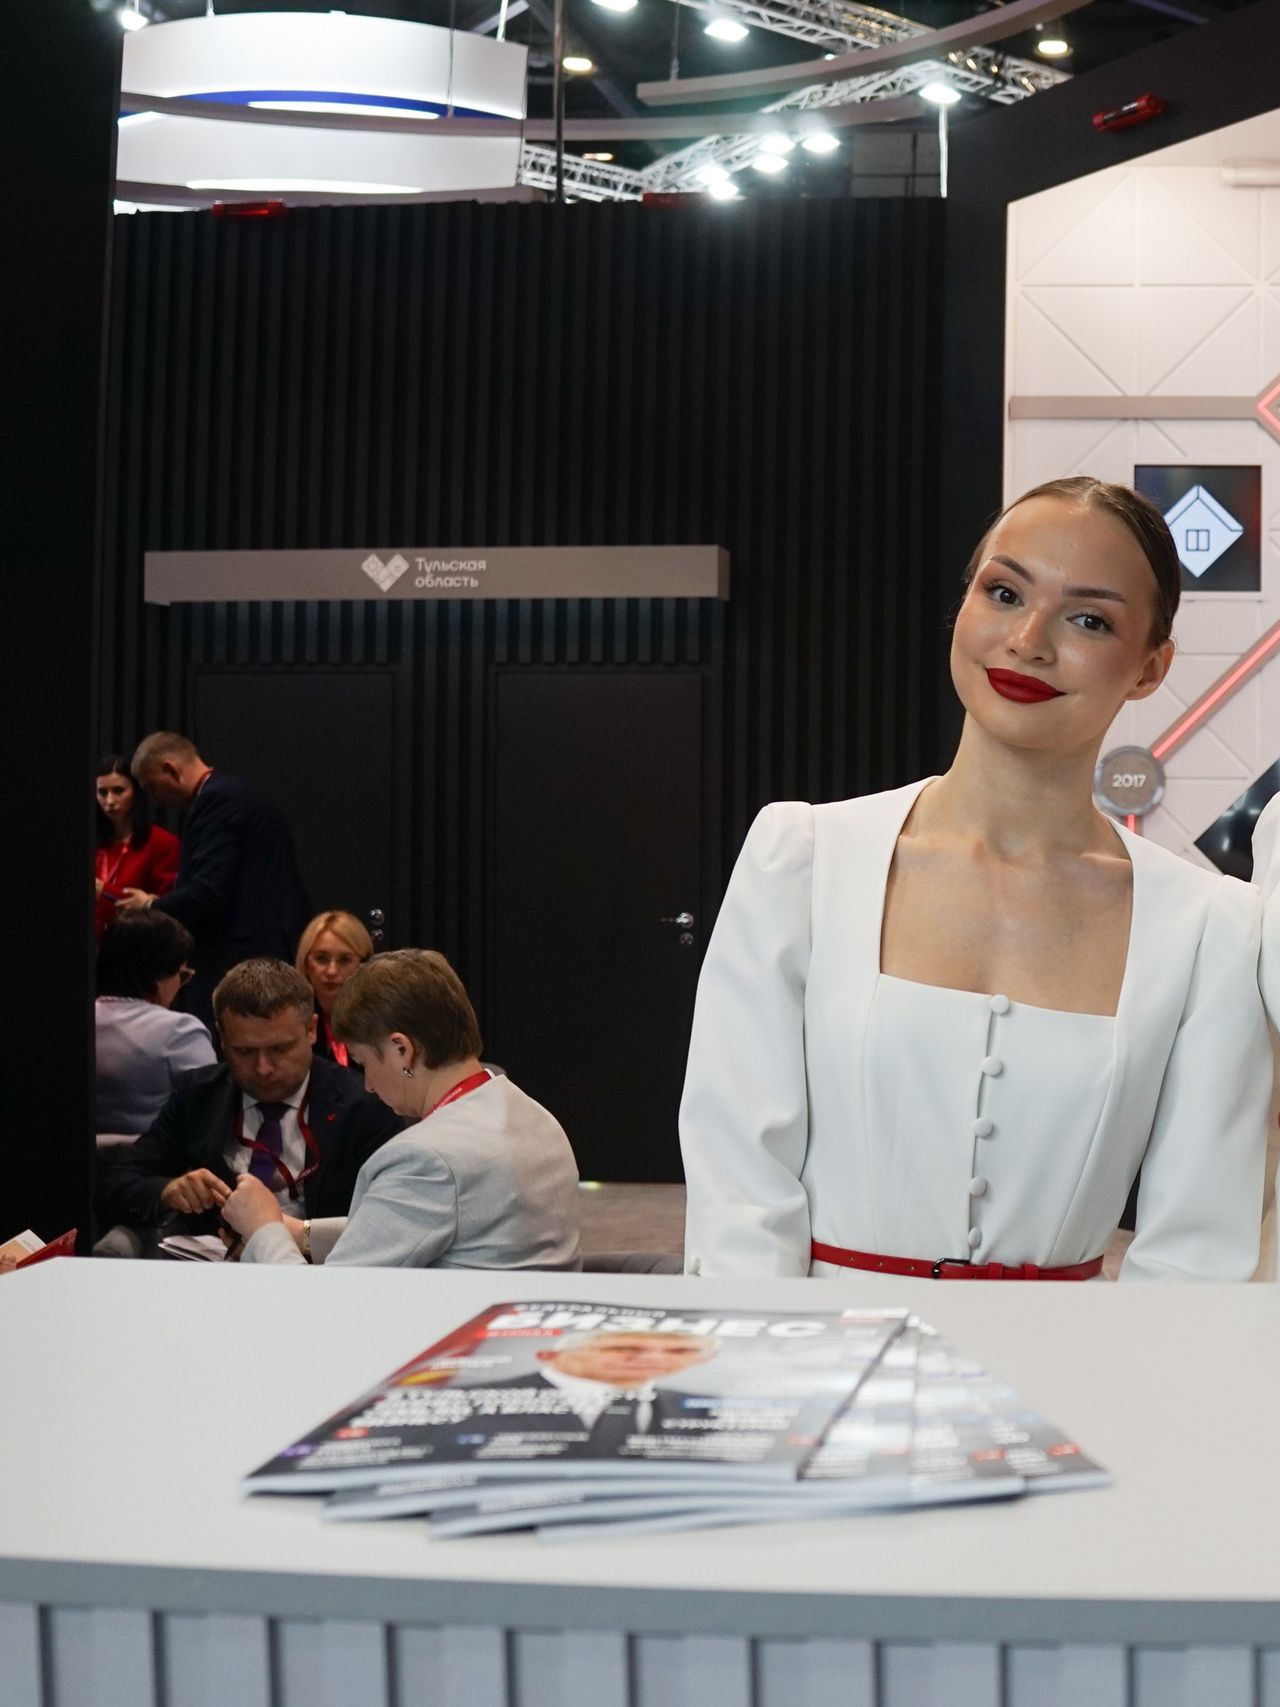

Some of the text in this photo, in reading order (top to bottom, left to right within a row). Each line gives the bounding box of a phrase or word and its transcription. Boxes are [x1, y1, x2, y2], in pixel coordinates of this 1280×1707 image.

[415, 557, 487, 573] Тульская
[415, 573, 479, 588] область
[1112, 773, 1147, 788] 2017
